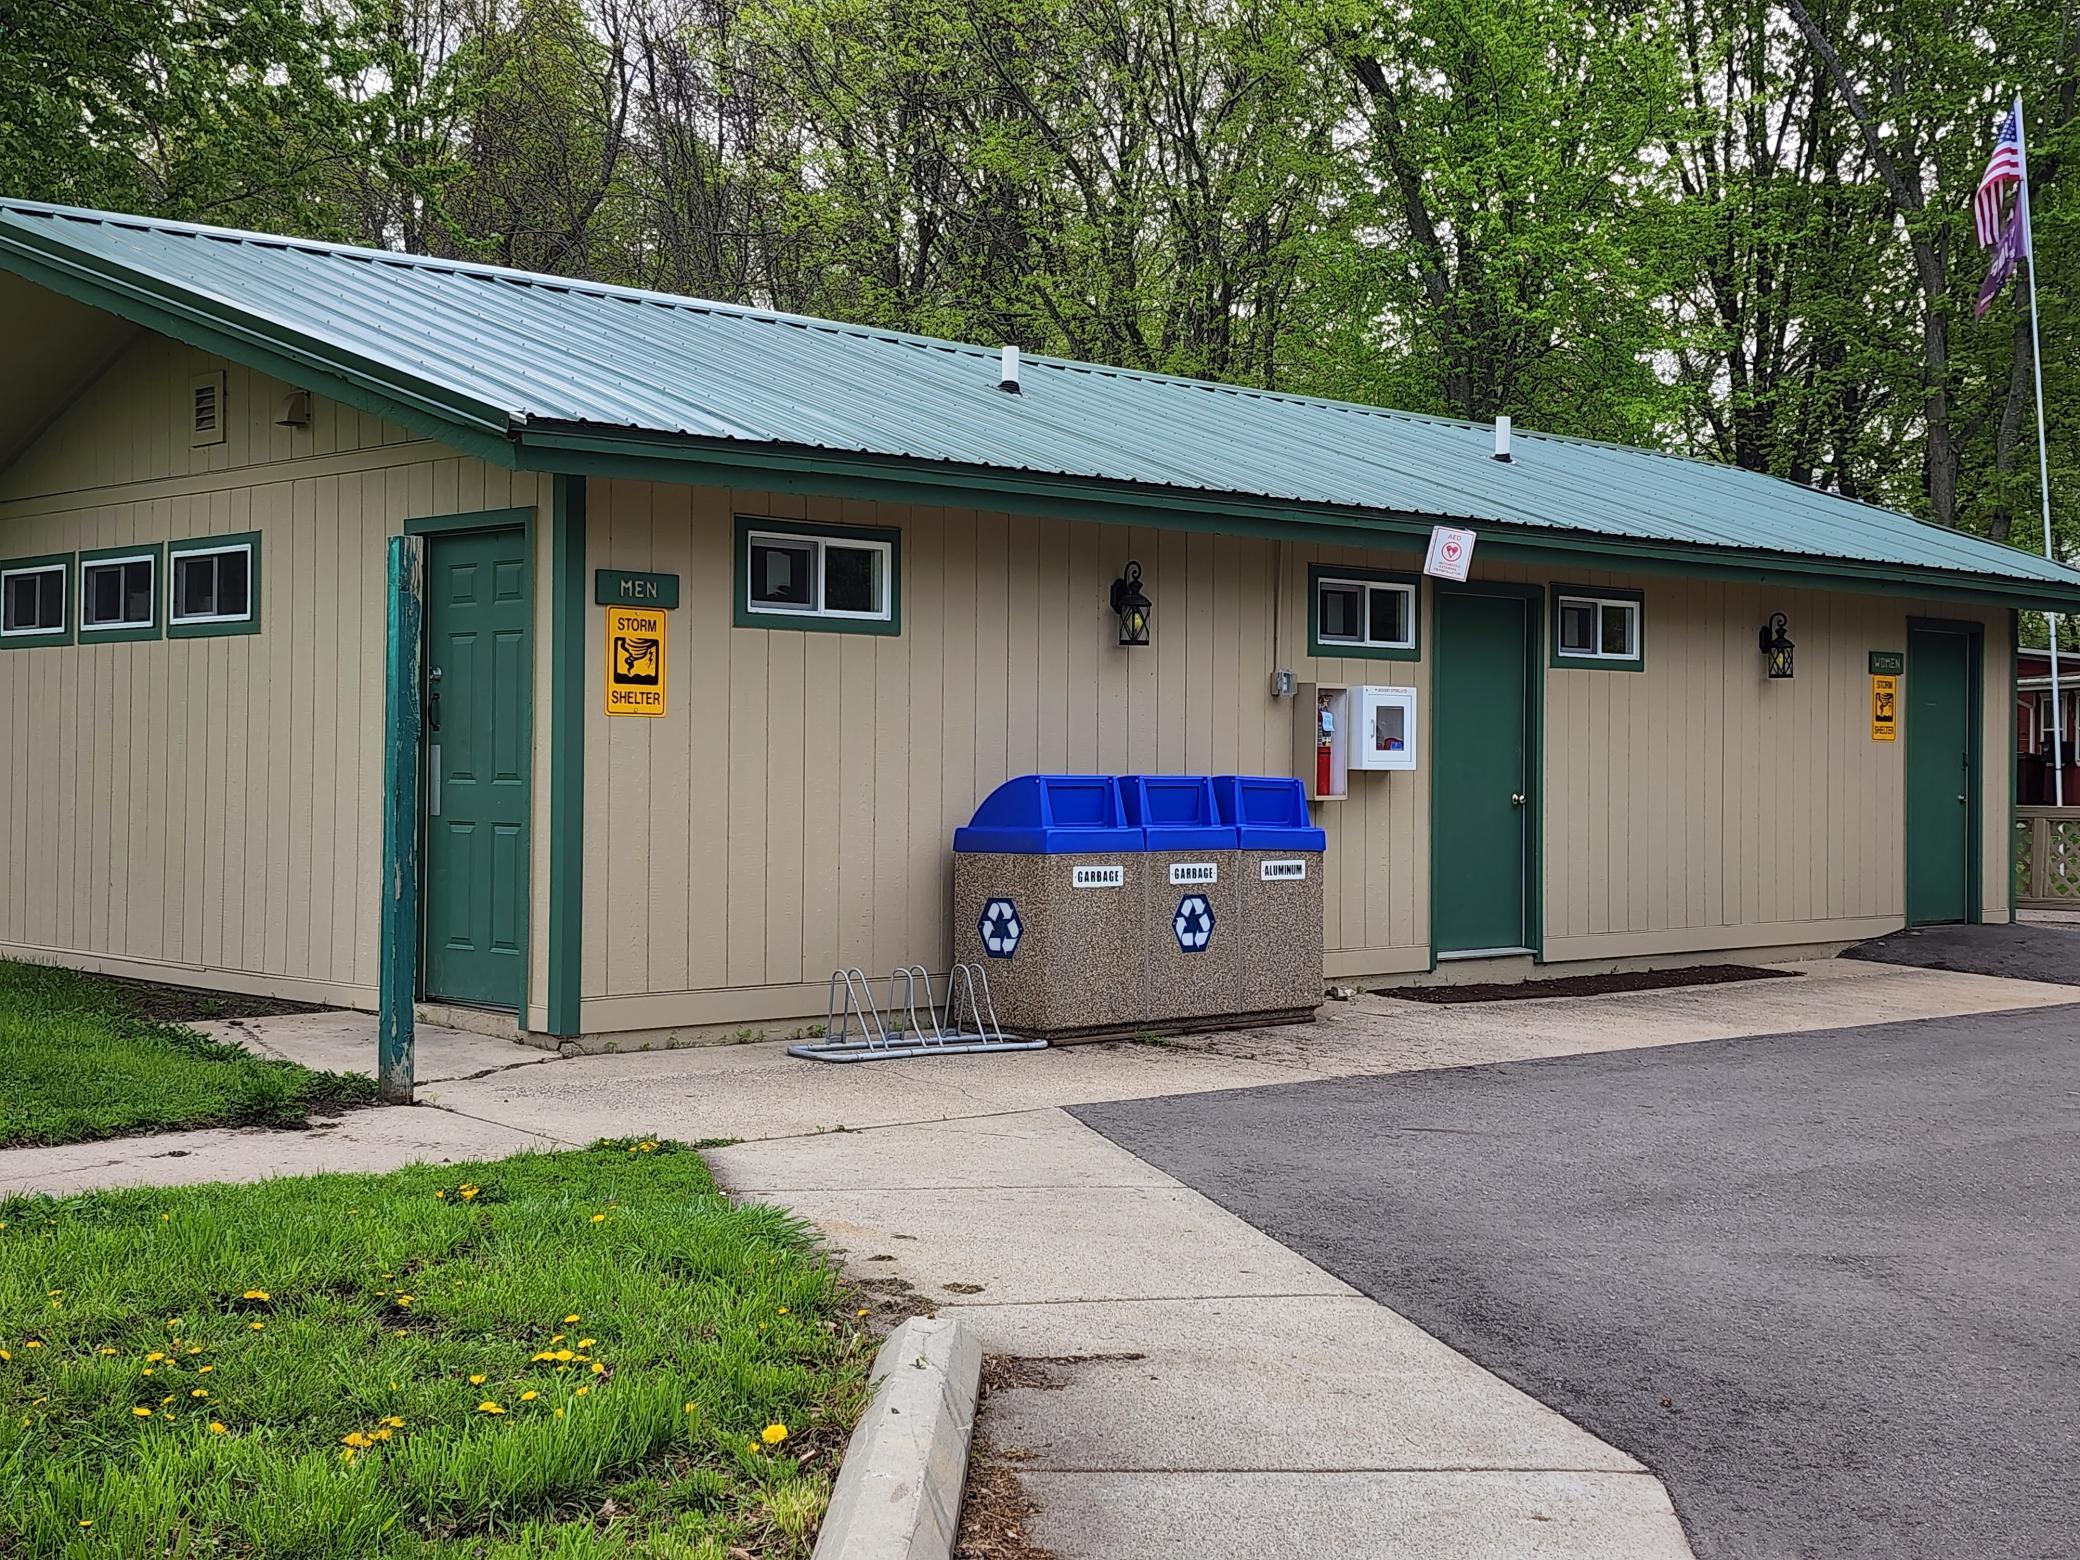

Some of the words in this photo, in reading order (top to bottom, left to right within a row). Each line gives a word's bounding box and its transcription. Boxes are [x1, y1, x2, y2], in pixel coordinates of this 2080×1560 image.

[620, 579, 657, 598] MEN
[617, 617, 657, 632] STORM
[1873, 656, 1900, 669] WOMEN
[1876, 680, 1893, 690] STORM
[611, 690, 660, 705] SHELTER
[1077, 870, 1119, 883] GARBAGE
[1174, 867, 1214, 880] GARBAGE
[1264, 864, 1302, 877] ALUMINUM
